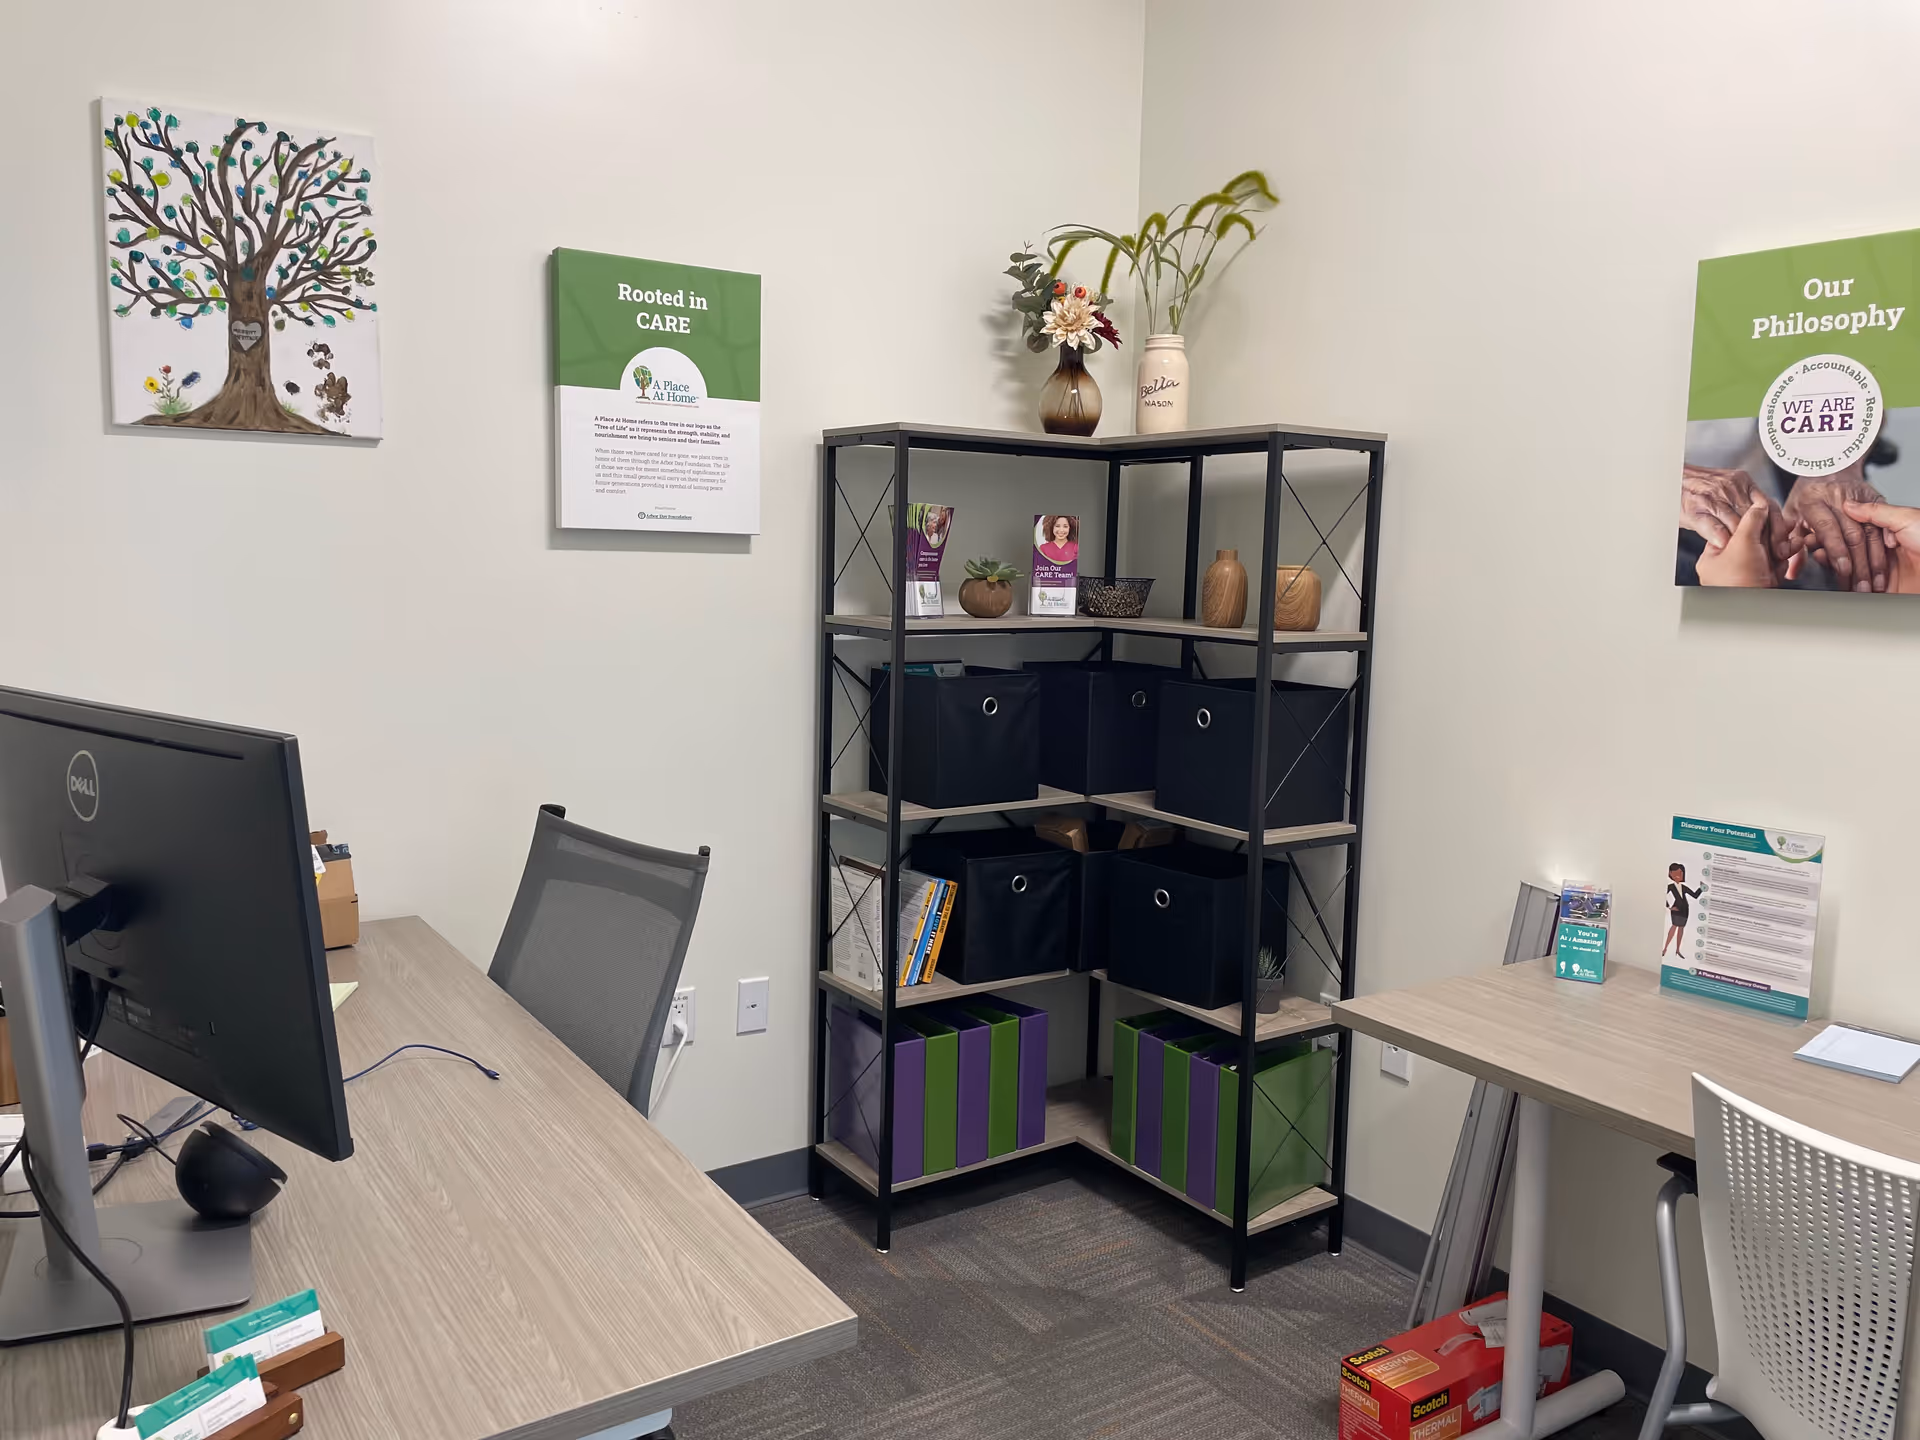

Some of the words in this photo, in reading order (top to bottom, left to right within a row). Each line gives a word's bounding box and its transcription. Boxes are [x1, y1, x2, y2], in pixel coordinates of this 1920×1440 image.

[618, 283, 684, 307] Rooted
[690, 292, 708, 310] in
[1803, 277, 1854, 300] Our
[636, 312, 690, 334] CARE
[1751, 304, 1905, 339] Philosophy
[653, 380, 660, 390] A
[663, 381, 689, 392] Place
[1803, 360, 1868, 390] Accountable
[653, 392, 664, 401] At
[1141, 376, 1180, 399] Bella
[1766, 374, 1795, 458] Compassionate
[1782, 400, 1814, 414] WE
[1820, 397, 1855, 412] ARE
[1780, 413, 1854, 434] CARE
[1842, 397, 1876, 459] Respectful
[1792, 456, 1836, 469] Ethical
[70, 776, 95, 797] DELL
[1681, 821, 1708, 831] Discover
[1726, 829, 1756, 839] Potential
[932, 915, 941, 930] LOVE
[925, 938, 934, 954] HERE
[1572, 937, 1603, 946] Amazing!
[1350, 1347, 1389, 1365] Scotch
[1368, 1353, 1419, 1376] THERMAL
[1341, 1367, 1370, 1391] Scotch
[1341, 1383, 1376, 1411] THERMAL
[1412, 1393, 1448, 1418] Scotch
[1412, 1412, 1457, 1440] THERMAL
